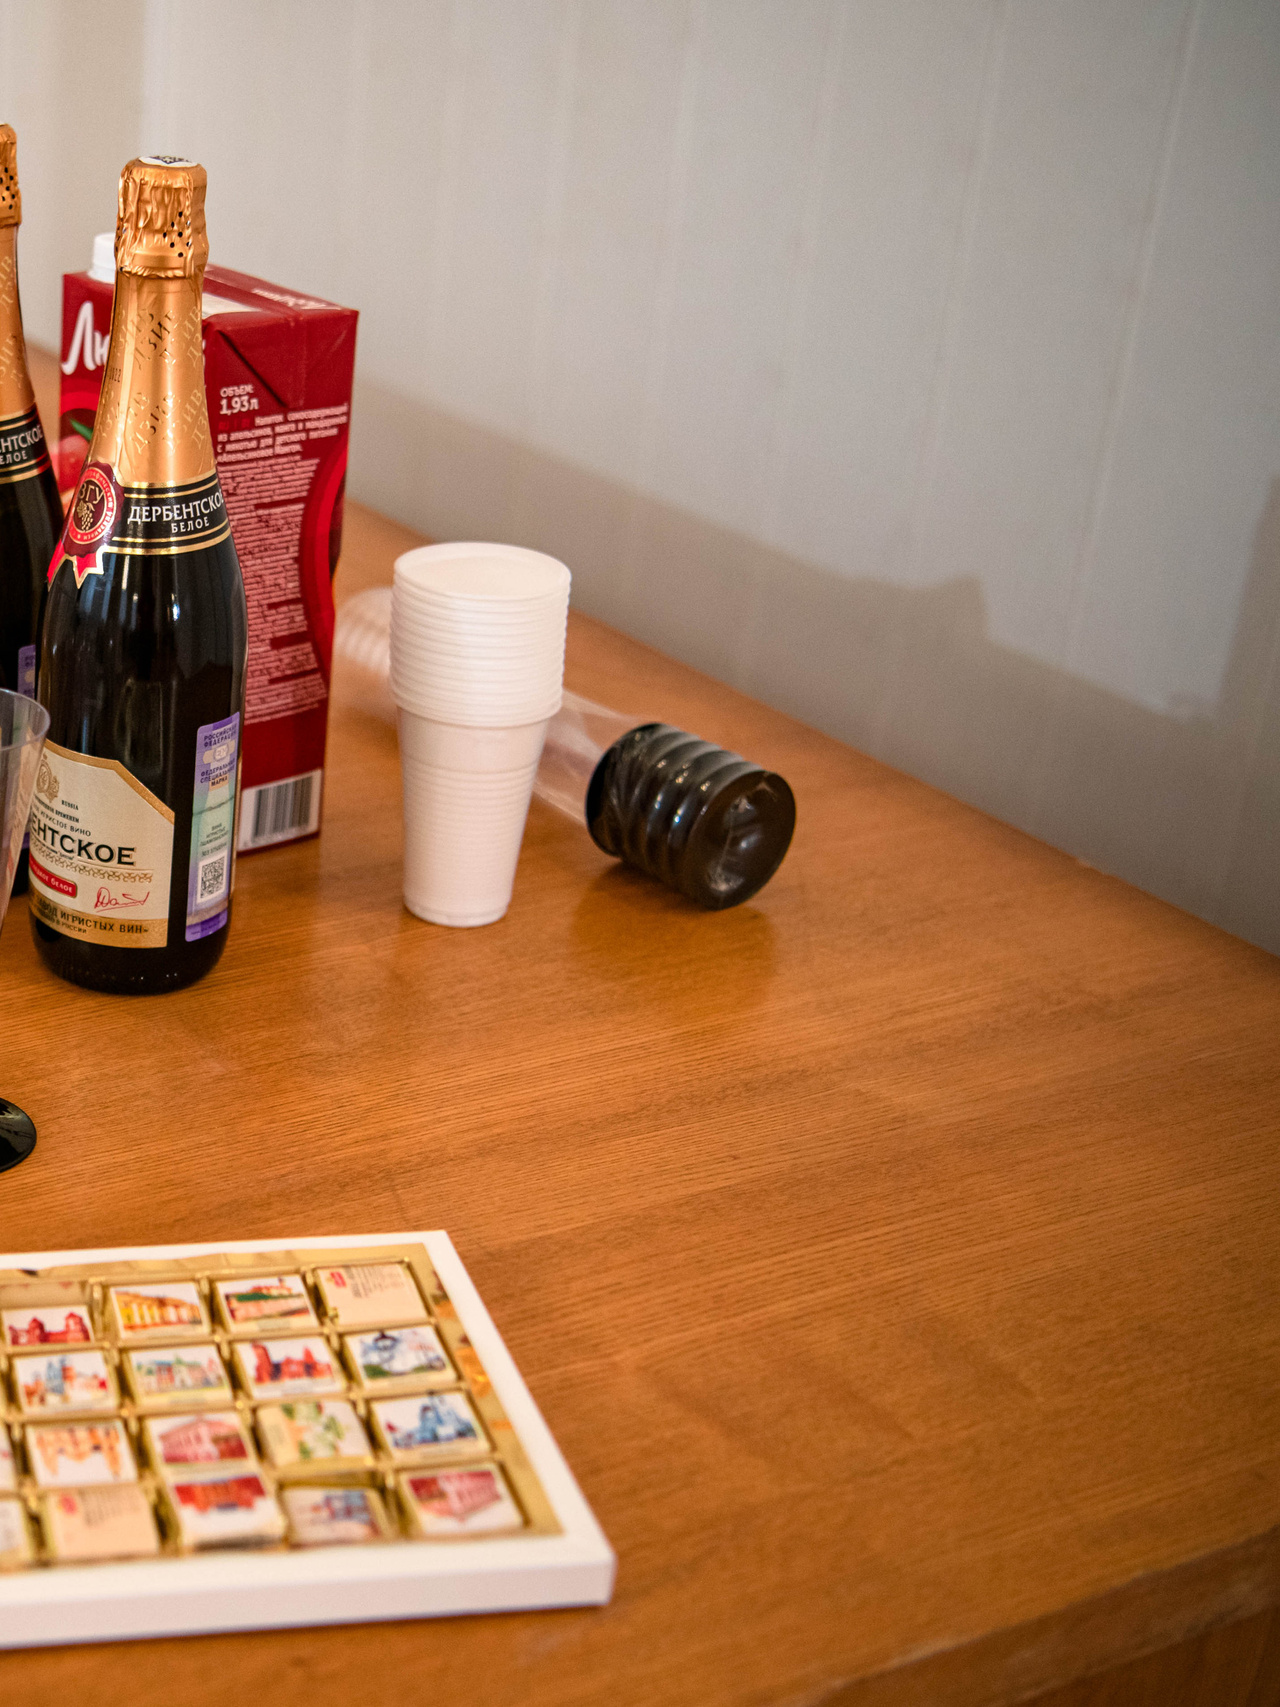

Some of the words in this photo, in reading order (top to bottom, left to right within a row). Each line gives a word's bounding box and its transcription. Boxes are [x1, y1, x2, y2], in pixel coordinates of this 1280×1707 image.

[80, 484, 105, 504] ЗГУ
[170, 518, 210, 534] БЕЛОЕ
[69, 825, 91, 837] ВИНО
[60, 910, 115, 932] ИГРИСТЫХ
